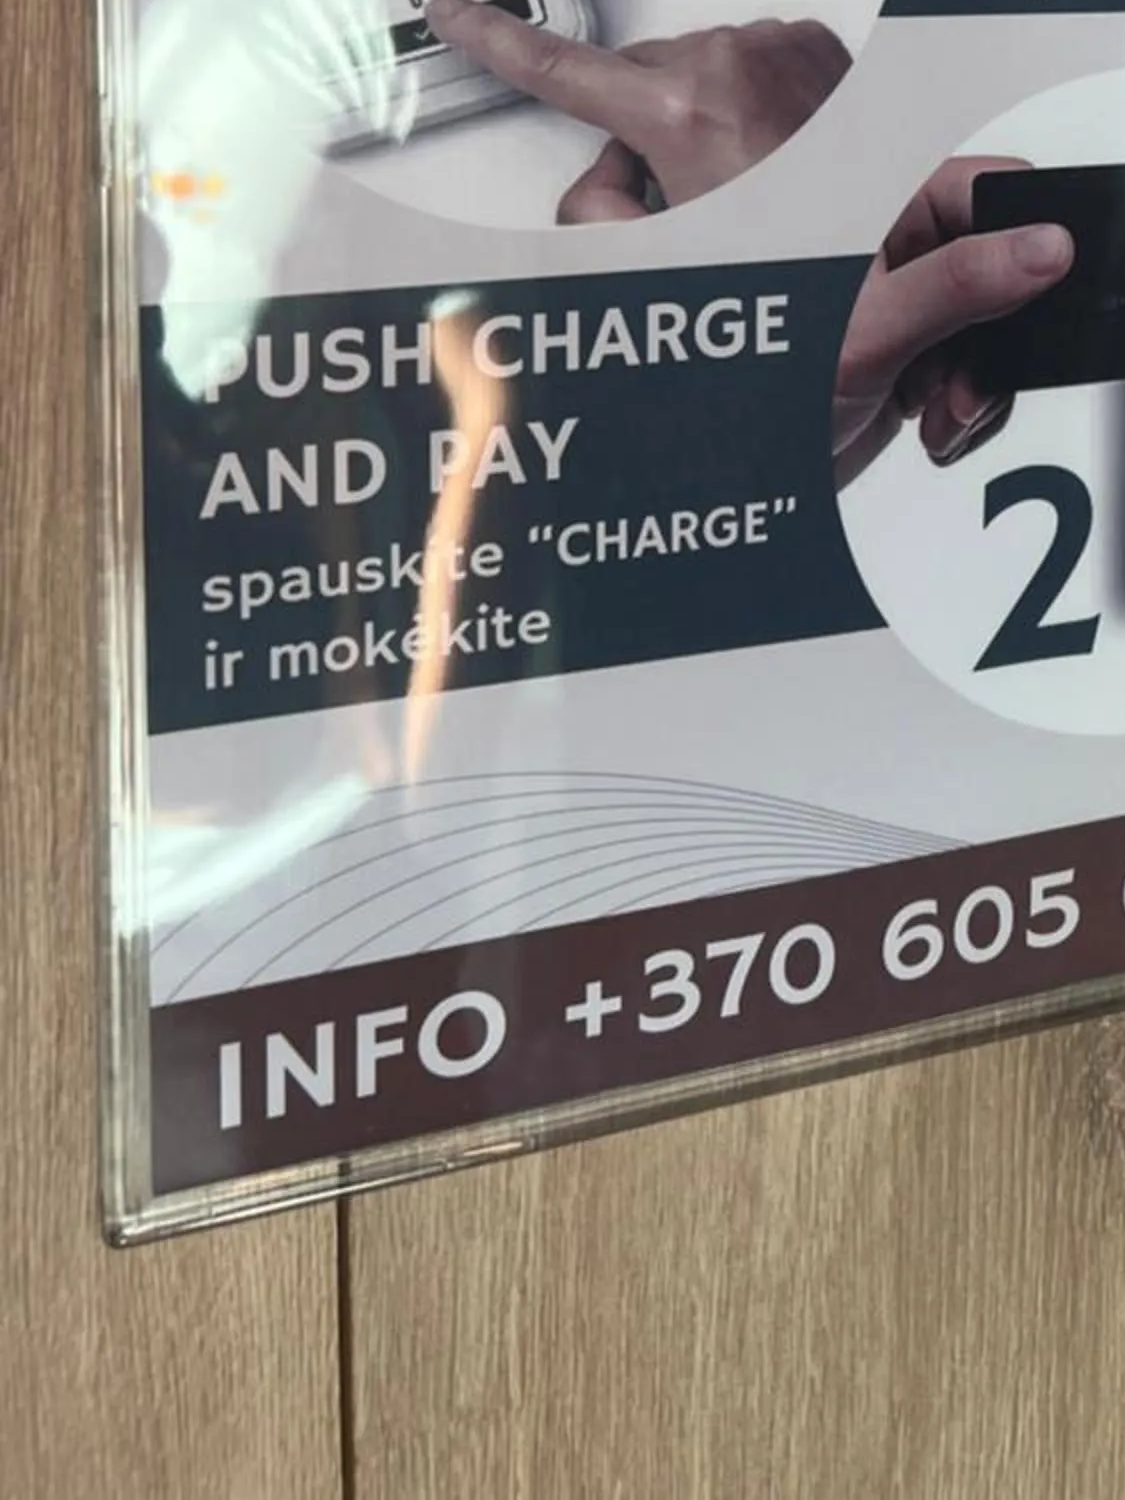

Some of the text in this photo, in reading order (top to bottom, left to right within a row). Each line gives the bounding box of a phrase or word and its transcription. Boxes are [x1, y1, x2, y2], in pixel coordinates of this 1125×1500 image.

[204, 293, 791, 404] PUSH CHARGE
[199, 416, 581, 520] AND PAY
[201, 535, 505, 620] spauskte
[972, 463, 1102, 673] 2
[204, 602, 551, 691] ir mokėkite
[219, 989, 507, 1131] INFO
[564, 923, 836, 1039] +370
[881, 867, 1081, 982] 605
